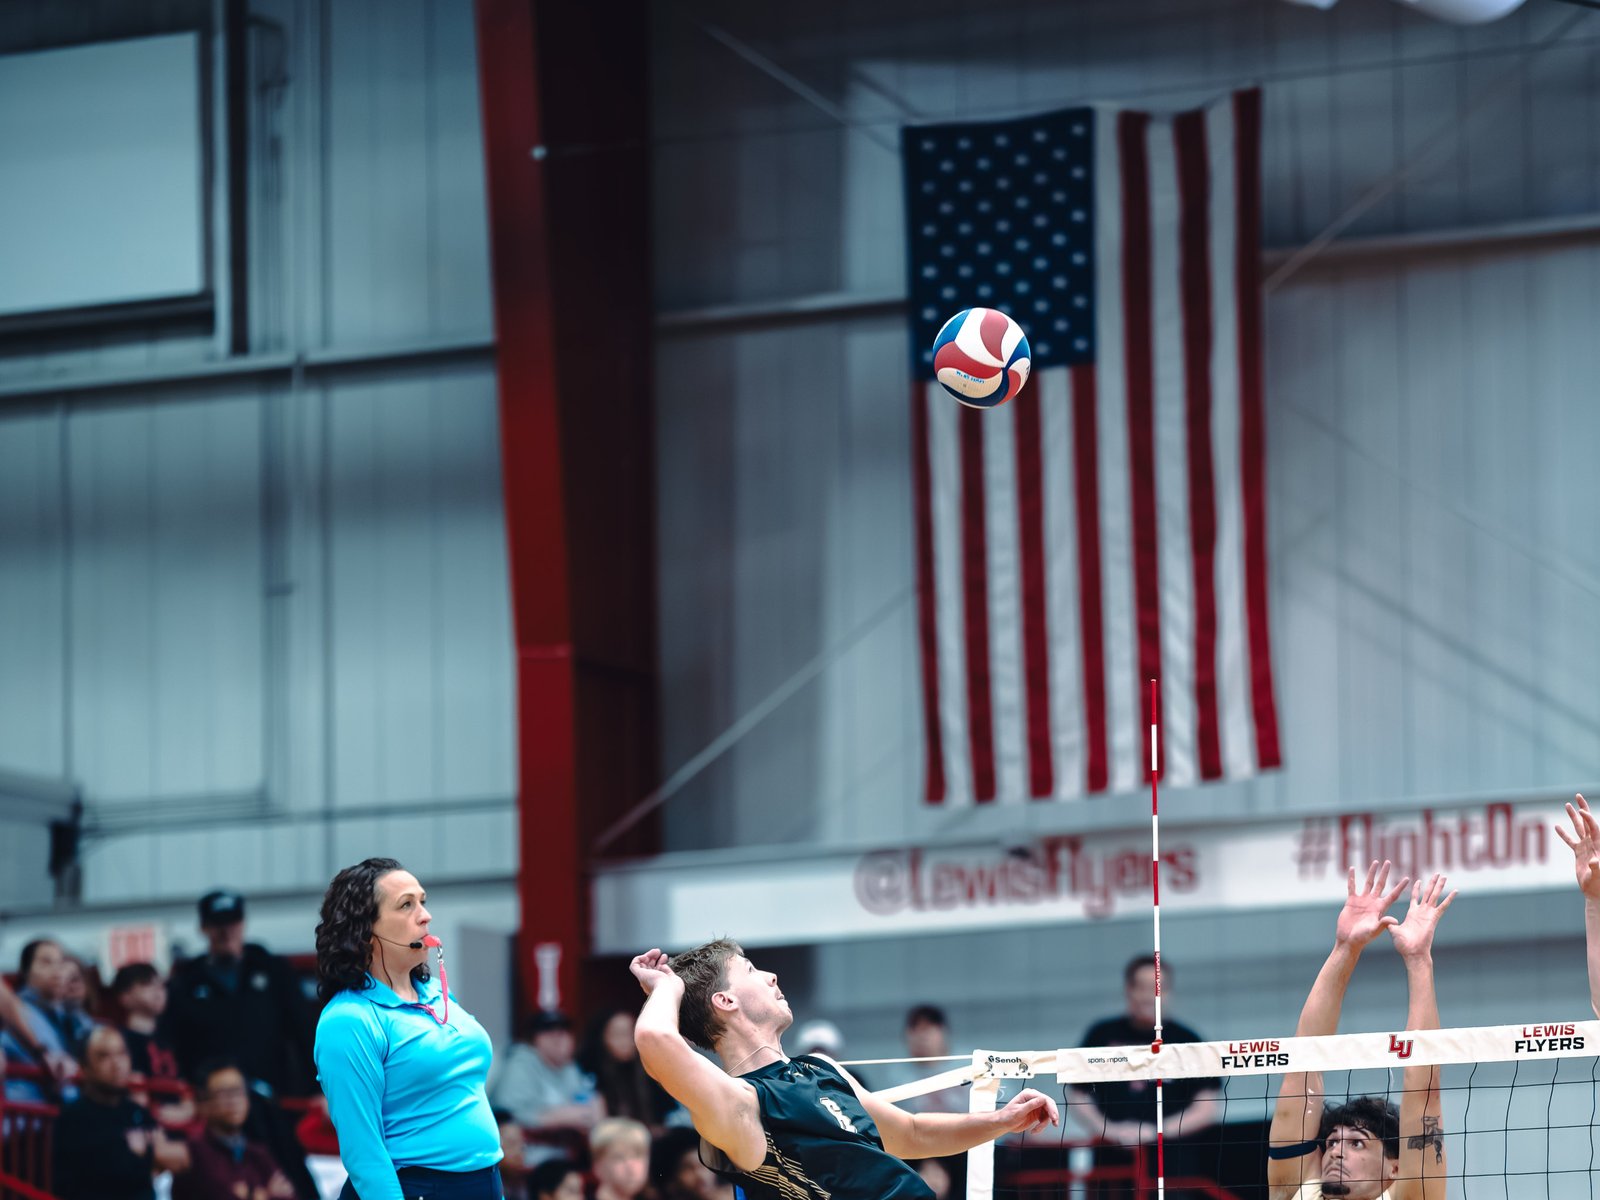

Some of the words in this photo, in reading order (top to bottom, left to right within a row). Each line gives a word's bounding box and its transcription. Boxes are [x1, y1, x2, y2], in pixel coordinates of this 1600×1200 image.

[1522, 1024, 1575, 1038] LEWIS
[1228, 1040, 1280, 1054] LEWIS
[1514, 1036, 1585, 1053] FLYERS
[995, 1056, 1022, 1064] Senoh
[1221, 1053, 1289, 1069] FLYERS
